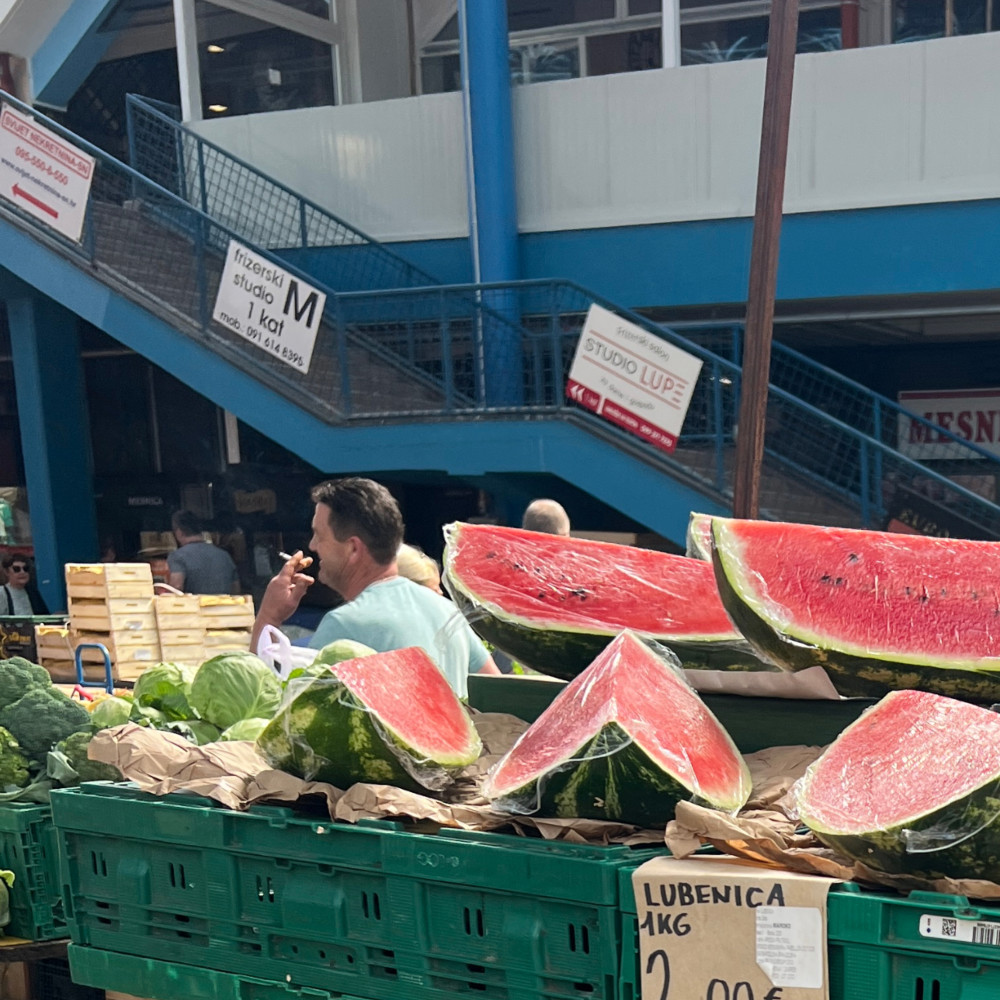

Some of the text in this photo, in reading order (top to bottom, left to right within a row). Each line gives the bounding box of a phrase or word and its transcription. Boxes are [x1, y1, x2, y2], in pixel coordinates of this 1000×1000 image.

[234, 248, 285, 288] frizerski
[233, 274, 274, 305] studio
[283, 279, 319, 329] M
[249, 301, 285, 337] 1 kat
[247, 326, 262, 342] 091
[264, 338, 281, 353] 614
[584, 338, 638, 375] STUDIO
[643, 882, 785, 908] LUBENICA
[640, 911, 692, 936] 1KG
